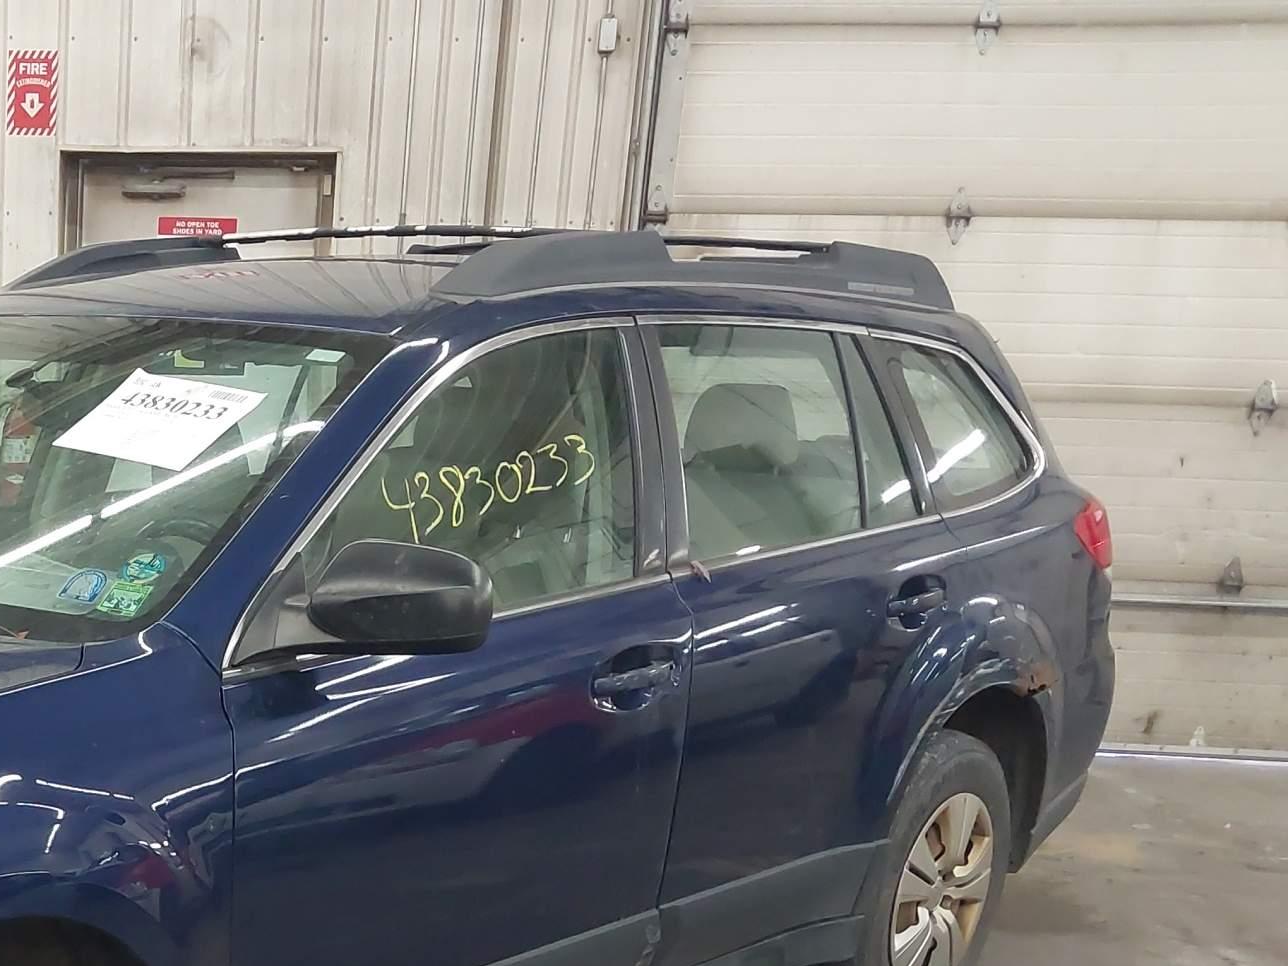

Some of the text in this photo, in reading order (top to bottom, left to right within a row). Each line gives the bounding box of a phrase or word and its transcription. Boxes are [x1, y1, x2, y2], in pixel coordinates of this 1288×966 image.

[19, 62, 48, 75] FIRE
[121, 391, 229, 420] 43830233
[381, 434, 596, 544] 43830233
